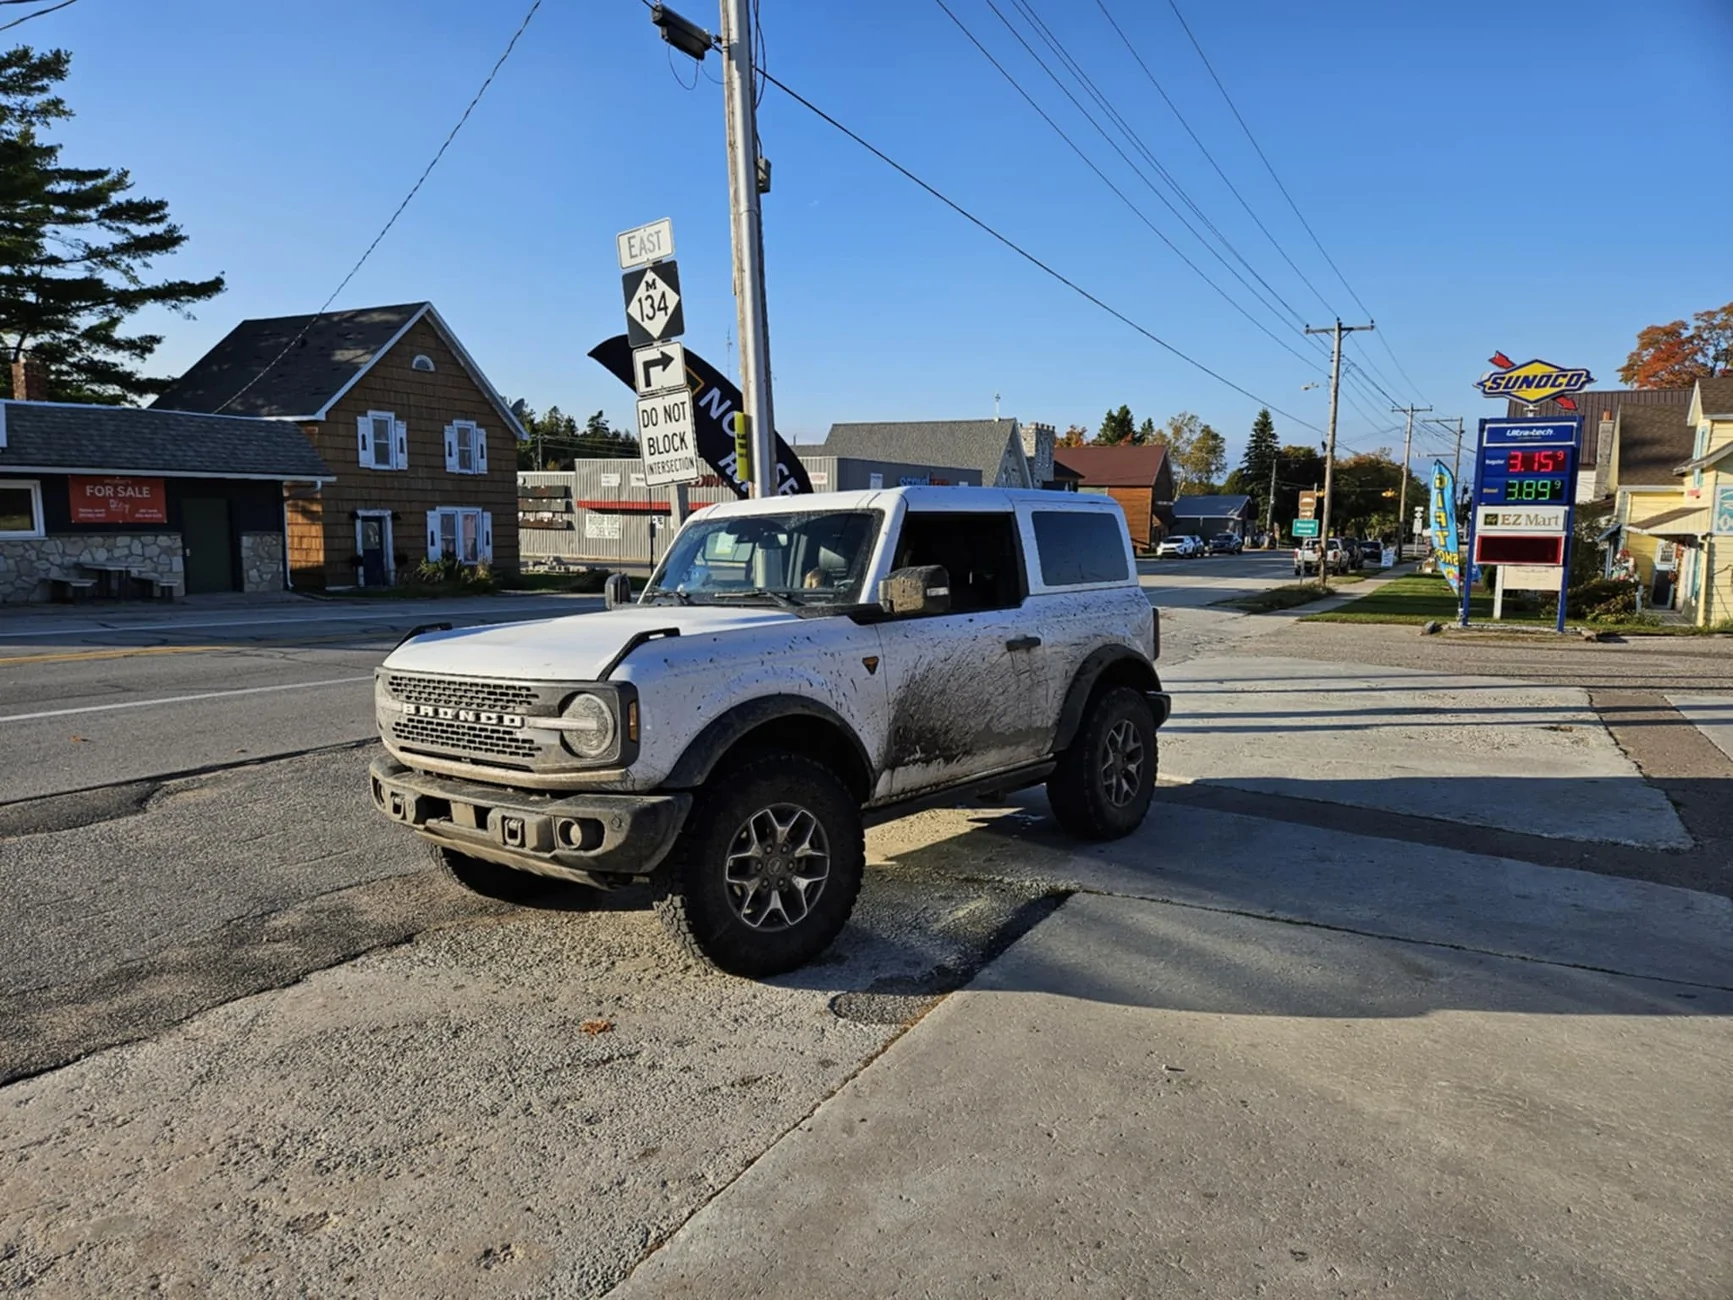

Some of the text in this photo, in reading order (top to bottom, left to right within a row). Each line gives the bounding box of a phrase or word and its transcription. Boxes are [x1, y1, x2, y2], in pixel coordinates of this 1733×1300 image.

[628, 231, 663, 259] EAST
[645, 279, 657, 291] M
[638, 291, 669, 323] 134
[1488, 371, 1584, 391] SUNOCO
[642, 401, 687, 429] DO NOT
[647, 432, 689, 457] BLOCK
[645, 456, 695, 477] INTERSECTION
[1508, 451, 1554, 472] 3.15
[86, 485, 151, 498] FOR SALE
[1506, 480, 1551, 500] 3.89
[1501, 513, 1559, 526] EZ Mart
[402, 702, 525, 728] BRONCO
